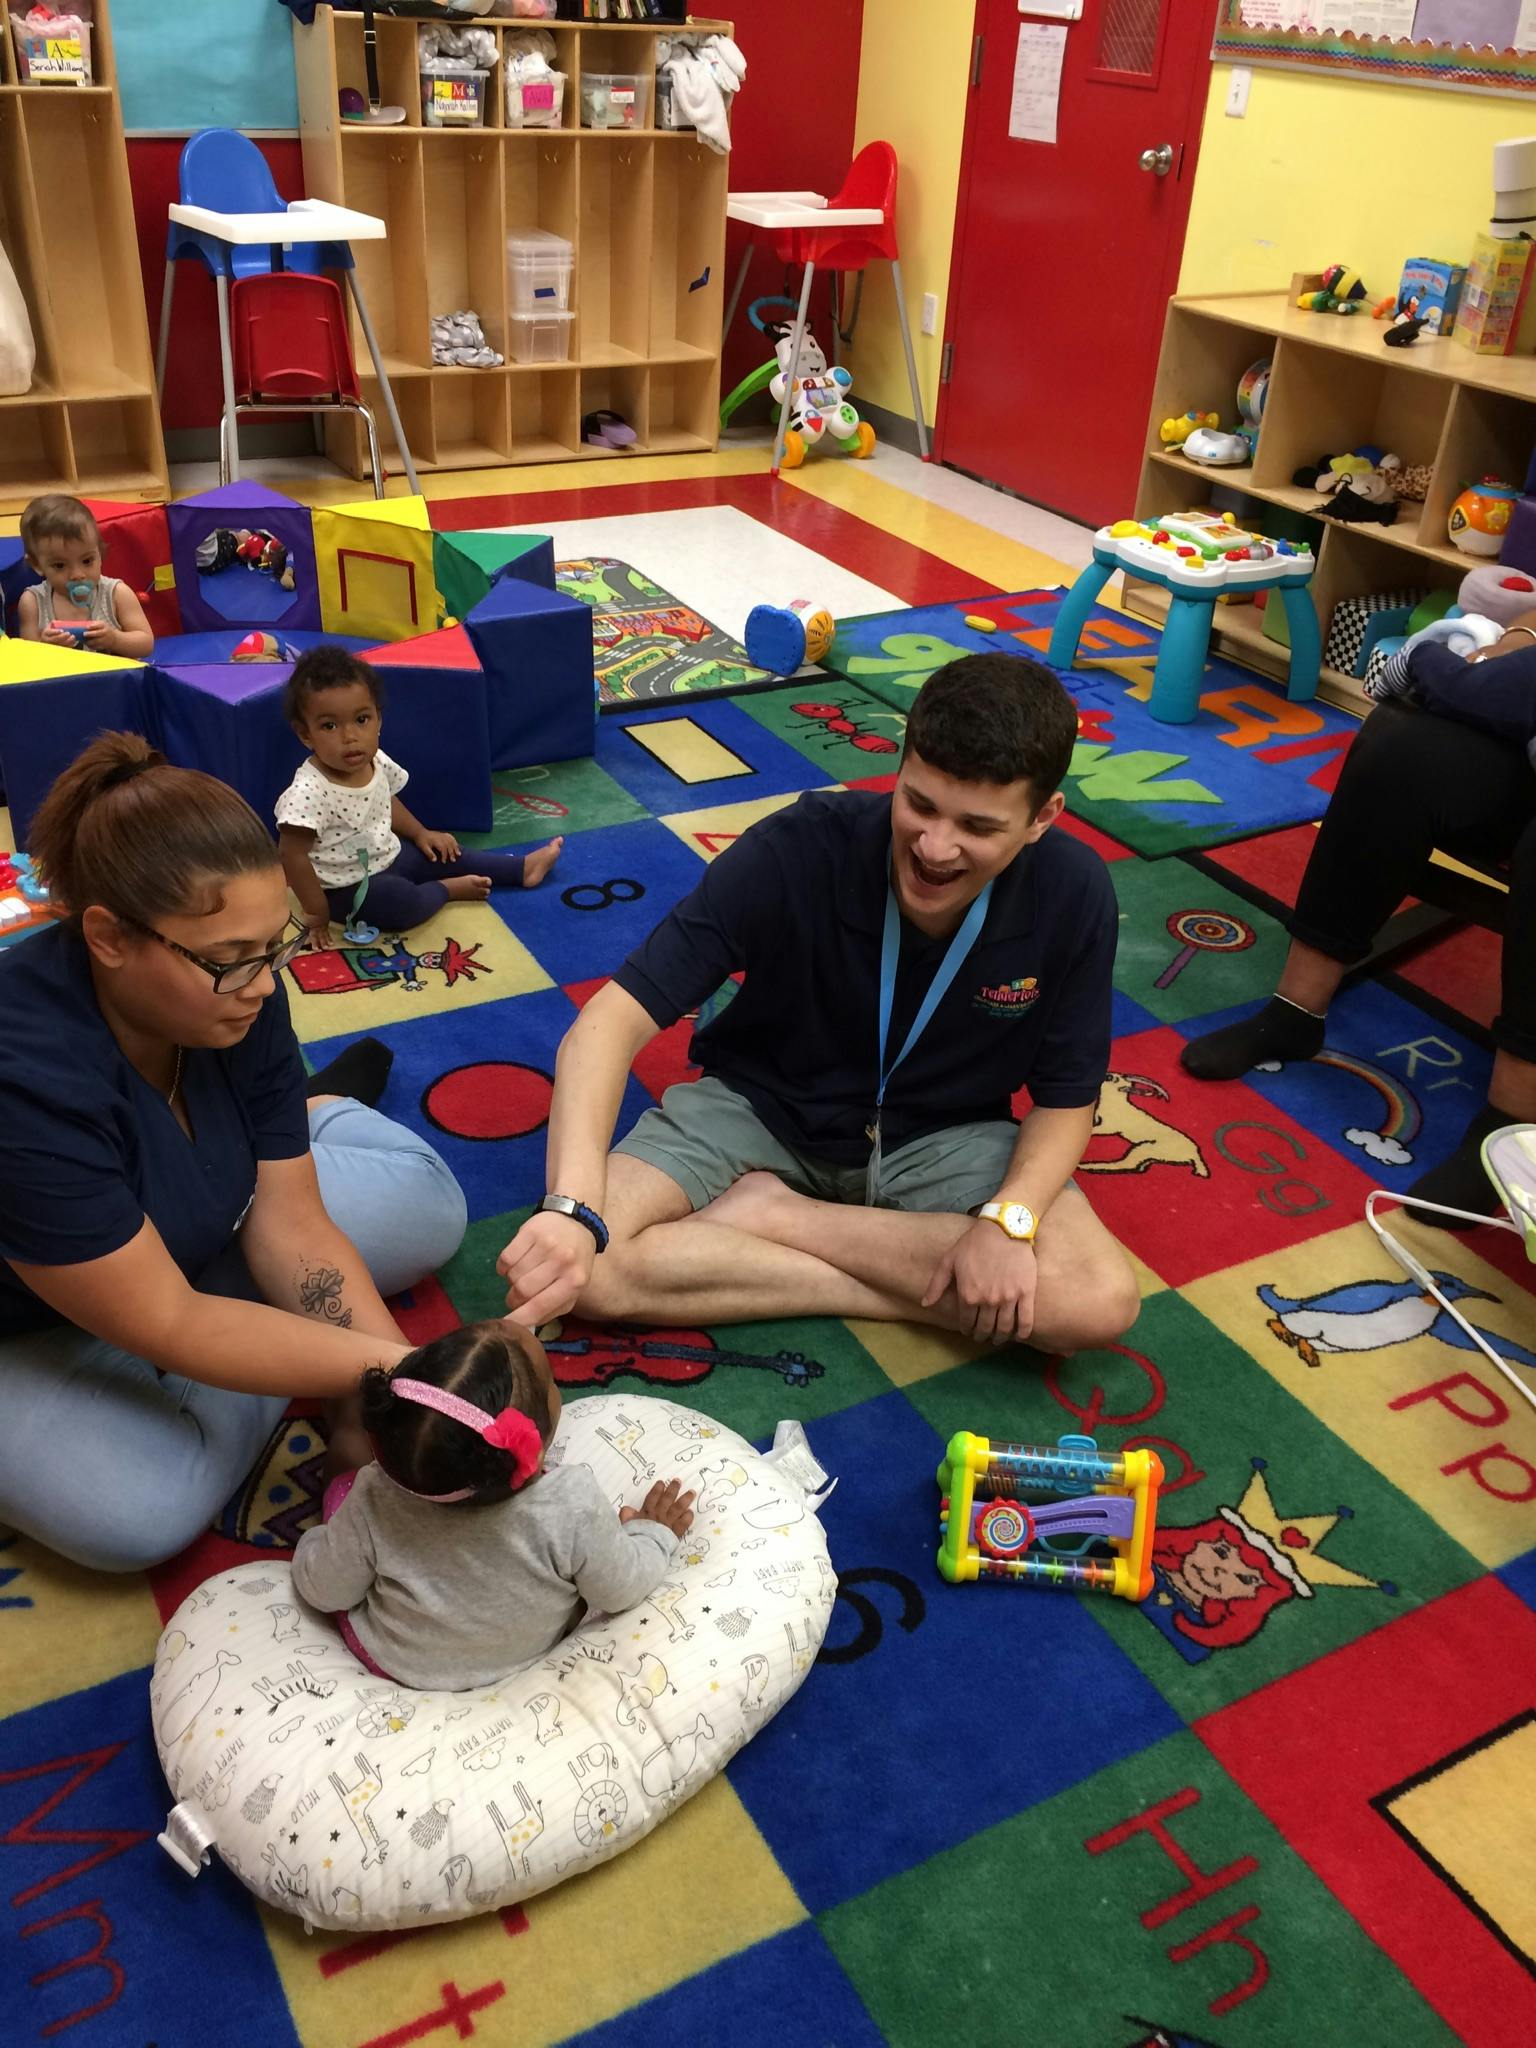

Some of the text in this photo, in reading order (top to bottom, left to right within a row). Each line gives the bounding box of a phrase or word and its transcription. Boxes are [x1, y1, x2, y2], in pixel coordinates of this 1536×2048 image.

[215, 1738, 245, 1774] HAPPY
[453, 1718, 514, 1760] HAPPY BABY
[290, 1789, 320, 1824] HELLO
[1084, 1786, 1270, 2016] Hh
